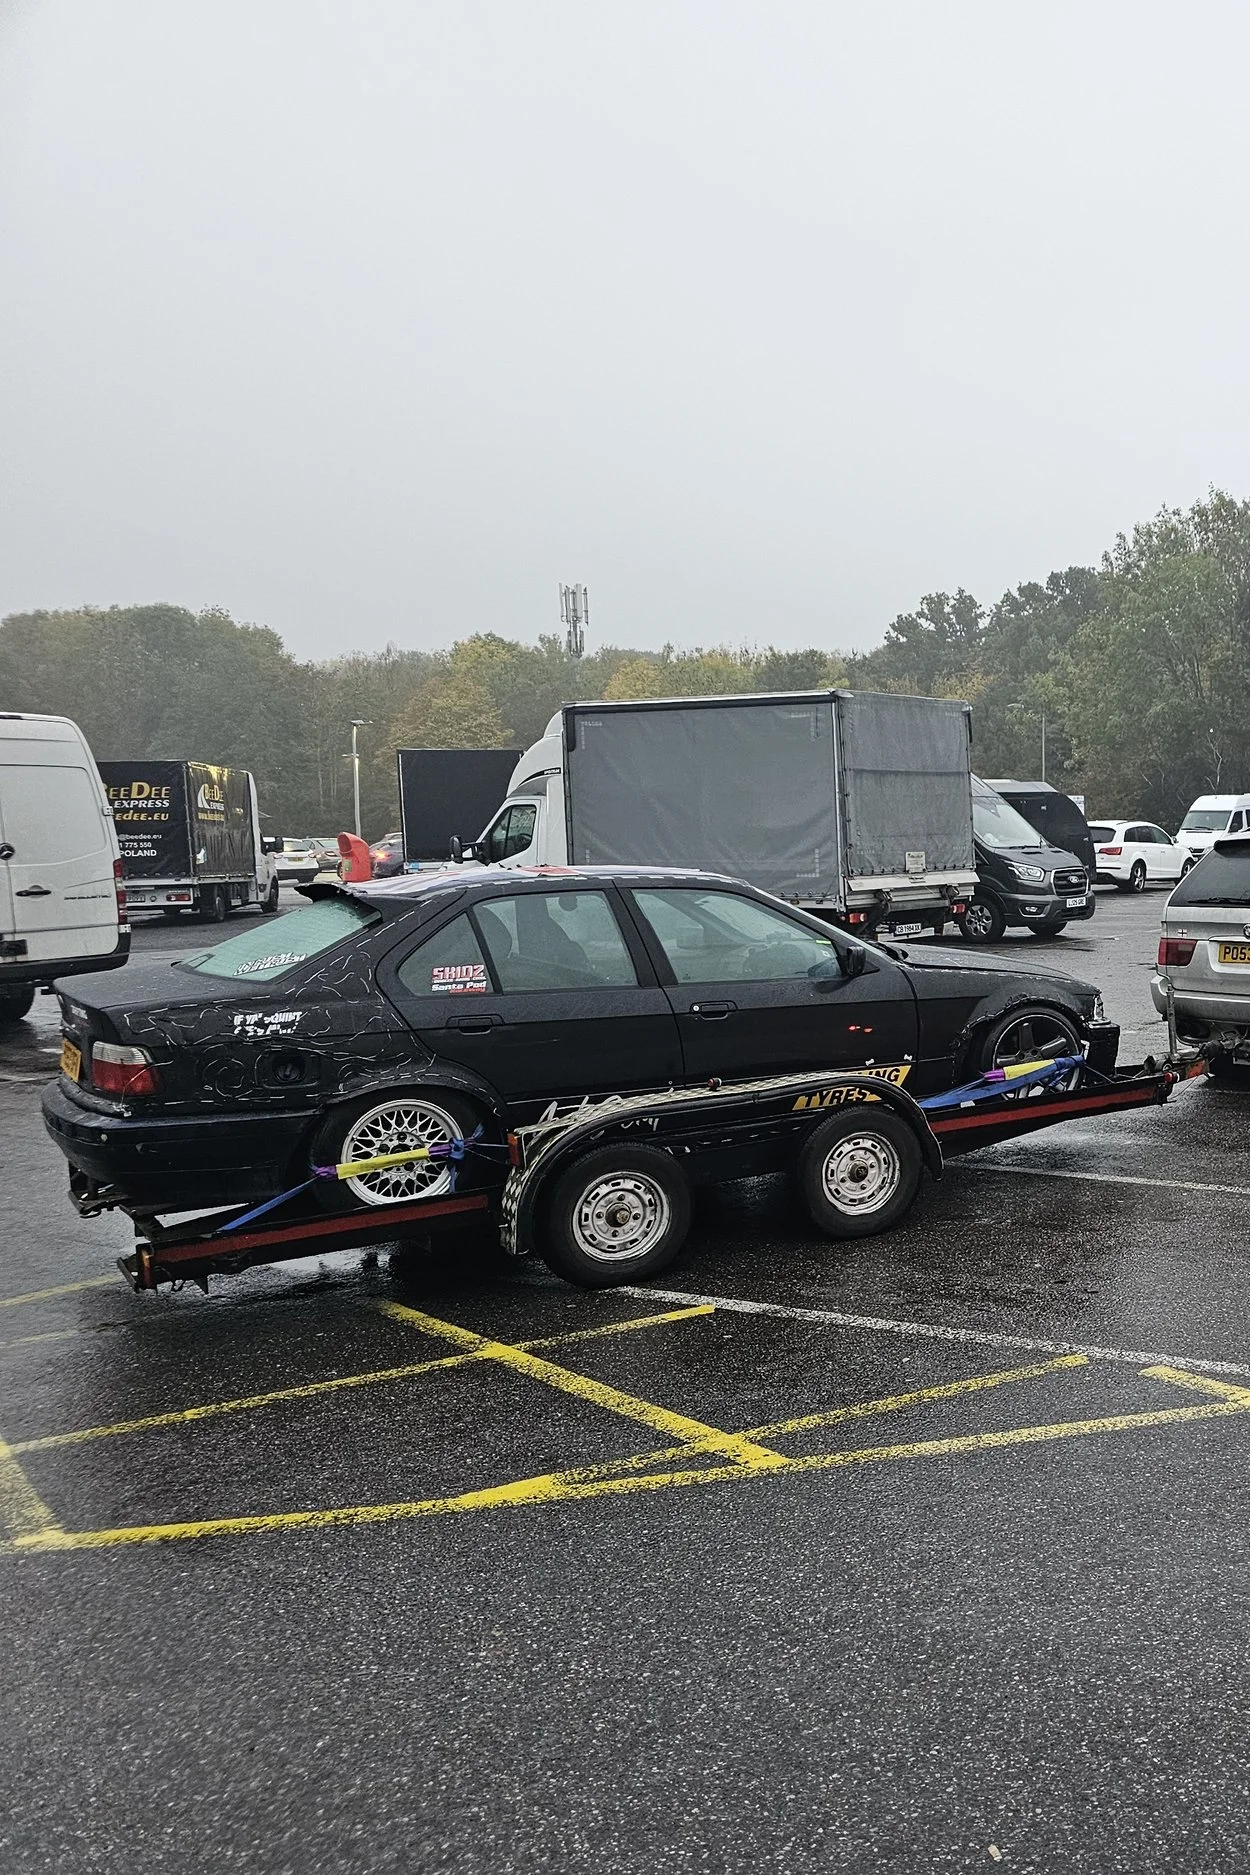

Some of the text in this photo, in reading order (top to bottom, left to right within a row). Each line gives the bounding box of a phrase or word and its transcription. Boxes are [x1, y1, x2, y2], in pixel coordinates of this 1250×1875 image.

[114, 800, 170, 808] EXPRESS
[432, 981, 487, 991] Santa Pod
[804, 1088, 868, 1108] TYRES
